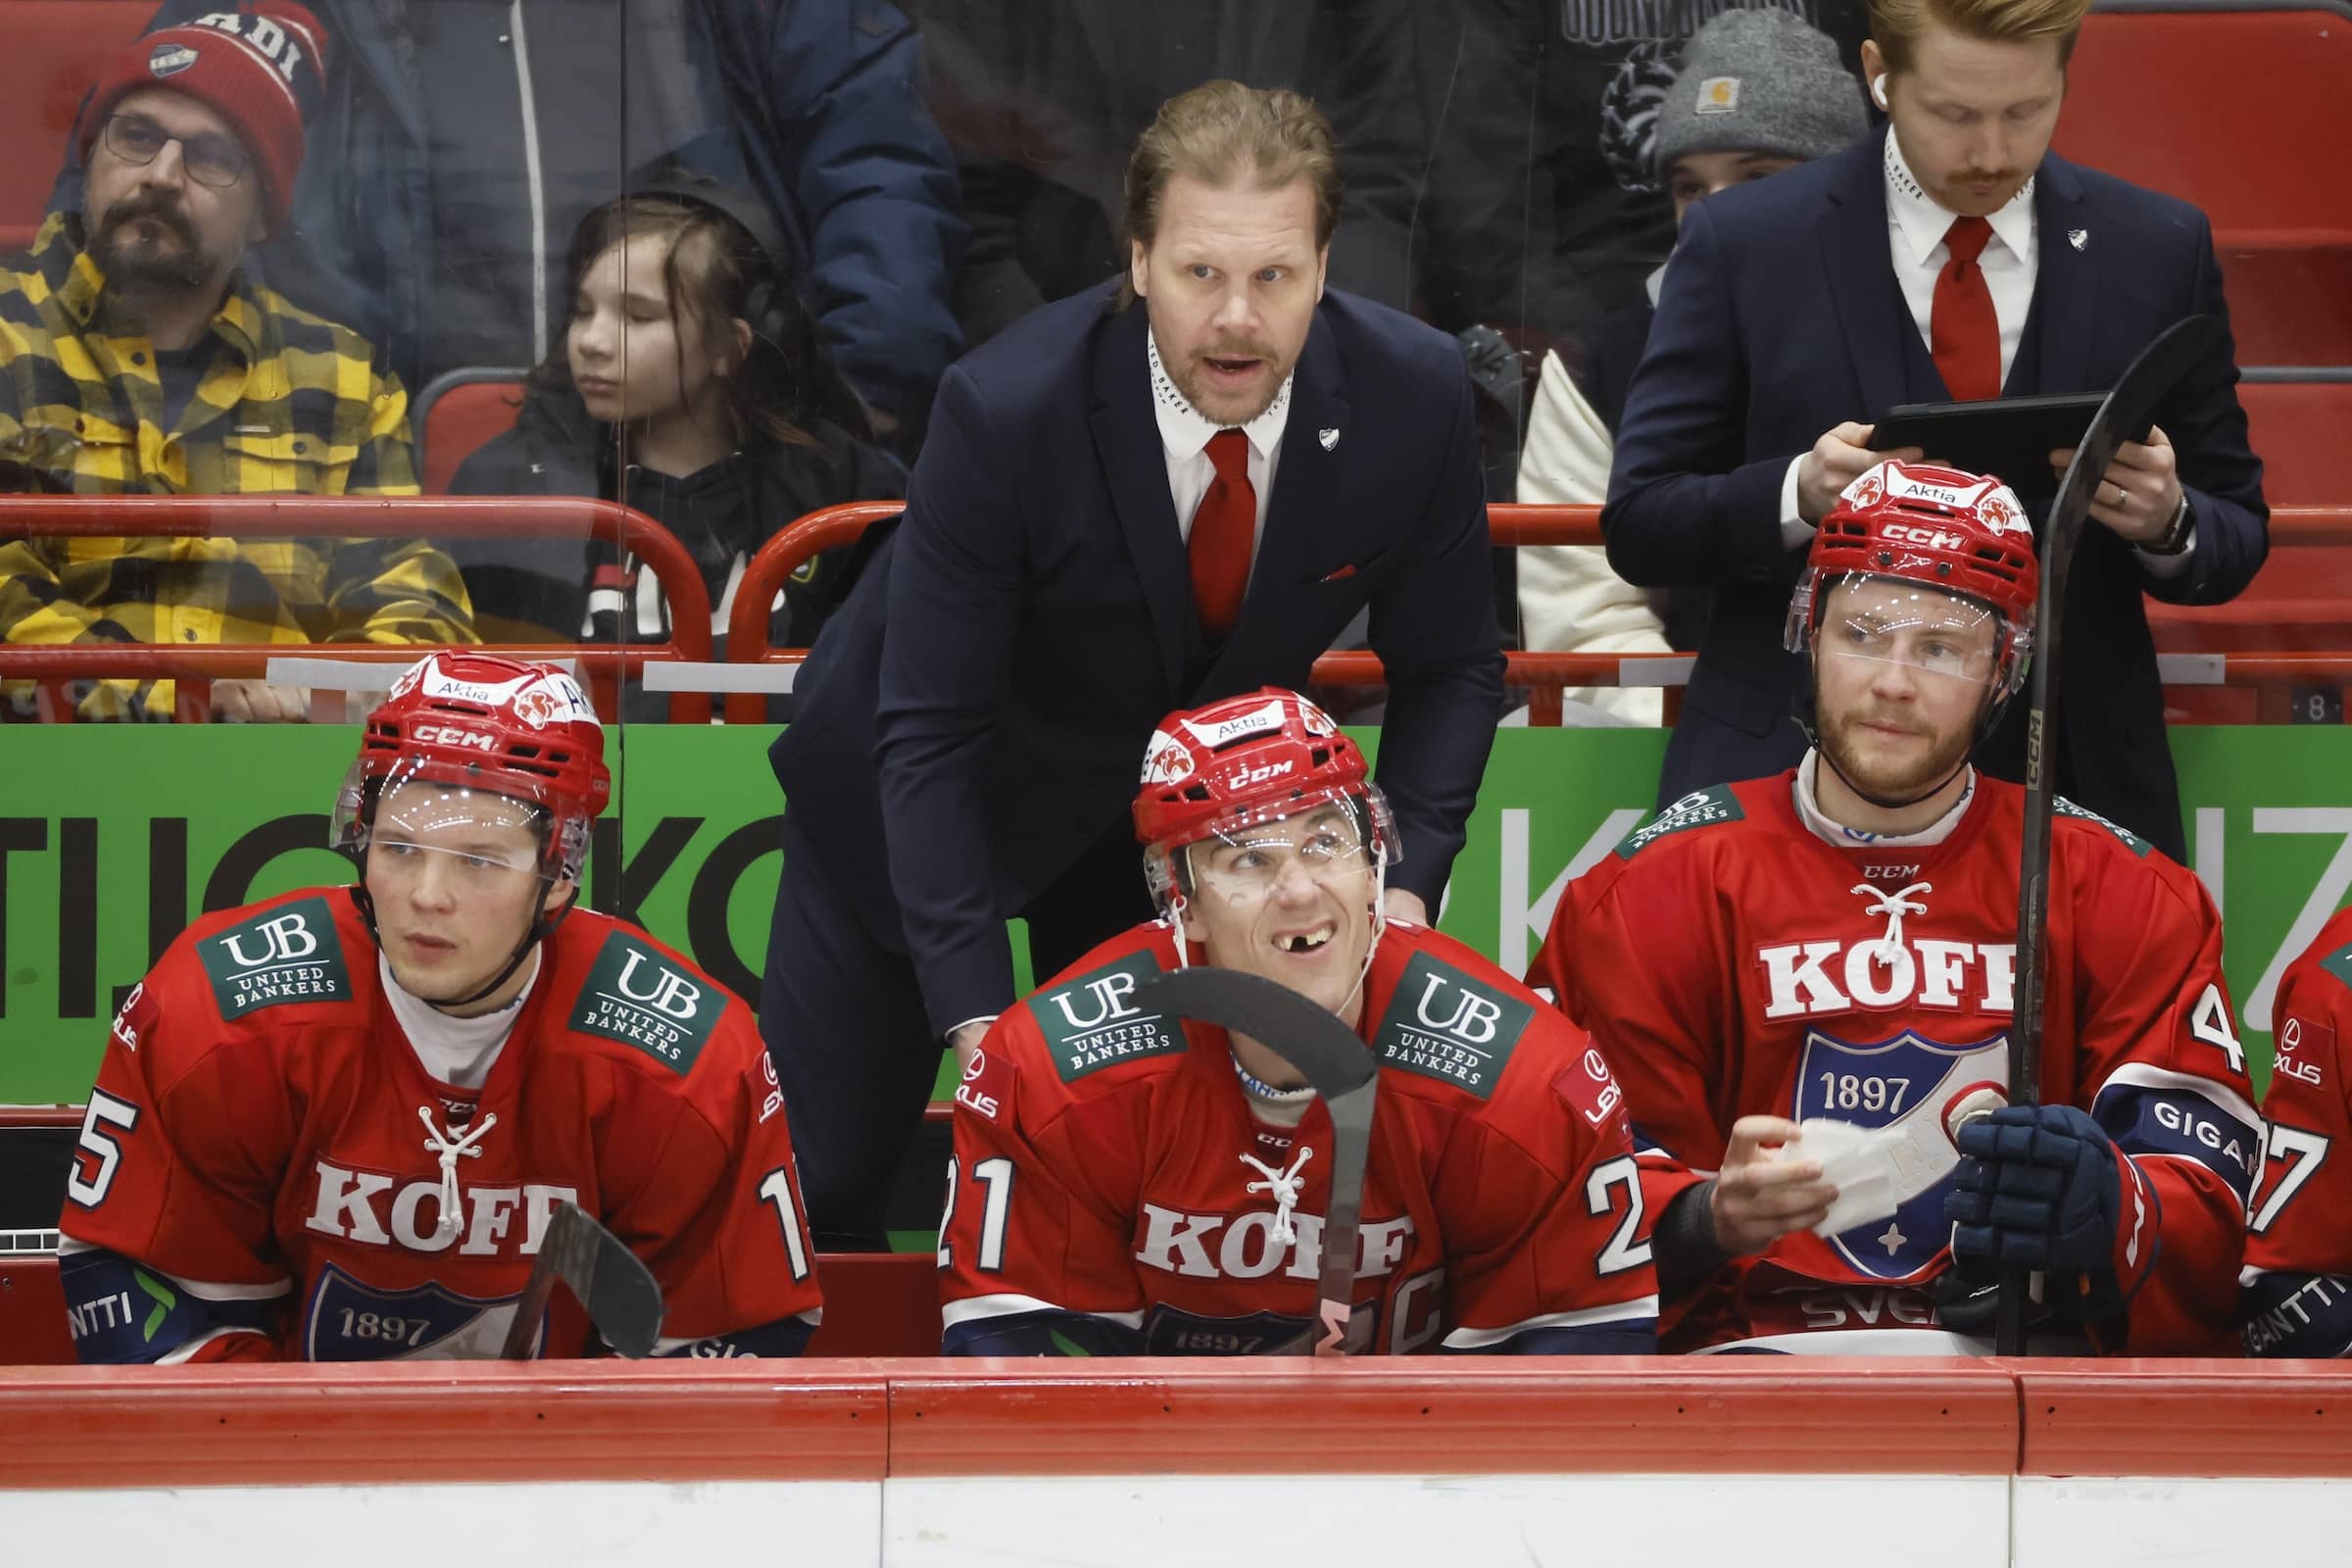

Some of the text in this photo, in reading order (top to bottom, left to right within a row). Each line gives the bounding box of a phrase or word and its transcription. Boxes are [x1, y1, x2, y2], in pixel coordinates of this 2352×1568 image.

[178, 13, 302, 82] ADI
[1904, 484, 1956, 504] Aktia
[1881, 524, 1966, 550] CCM
[439, 681, 489, 702] Aktia
[2307, 694, 2326, 720] 8
[414, 724, 495, 752] CCM
[1217, 713, 1268, 740] Aktia
[2028, 714, 2042, 784] CCM
[1228, 760, 1294, 791] CCM
[1863, 863, 1921, 879] CCM
[219, 912, 318, 966] UB
[233, 980, 336, 1007] BANKERS
[238, 966, 324, 991] UNITED
[617, 948, 701, 1019] UB
[599, 1001, 681, 1044] UNITED
[1416, 971, 1501, 1044] UB
[2190, 982, 2245, 1073] 4
[584, 1011, 682, 1061] BANKERS
[1069, 1034, 1171, 1070] BANKERS
[1073, 1023, 1157, 1053] UNITED
[1400, 1032, 1480, 1069] UNITED
[1384, 1044, 1483, 1086] BANKERS
[1819, 1071, 1911, 1115] 1897
[68, 1088, 139, 1208] 5
[760, 1162, 815, 1281] 1
[1585, 1155, 1654, 1276] 2
[338, 1306, 432, 1348] 1897
[1799, 1286, 1938, 1329] SVE
[1175, 1330, 1264, 1356] 1897
